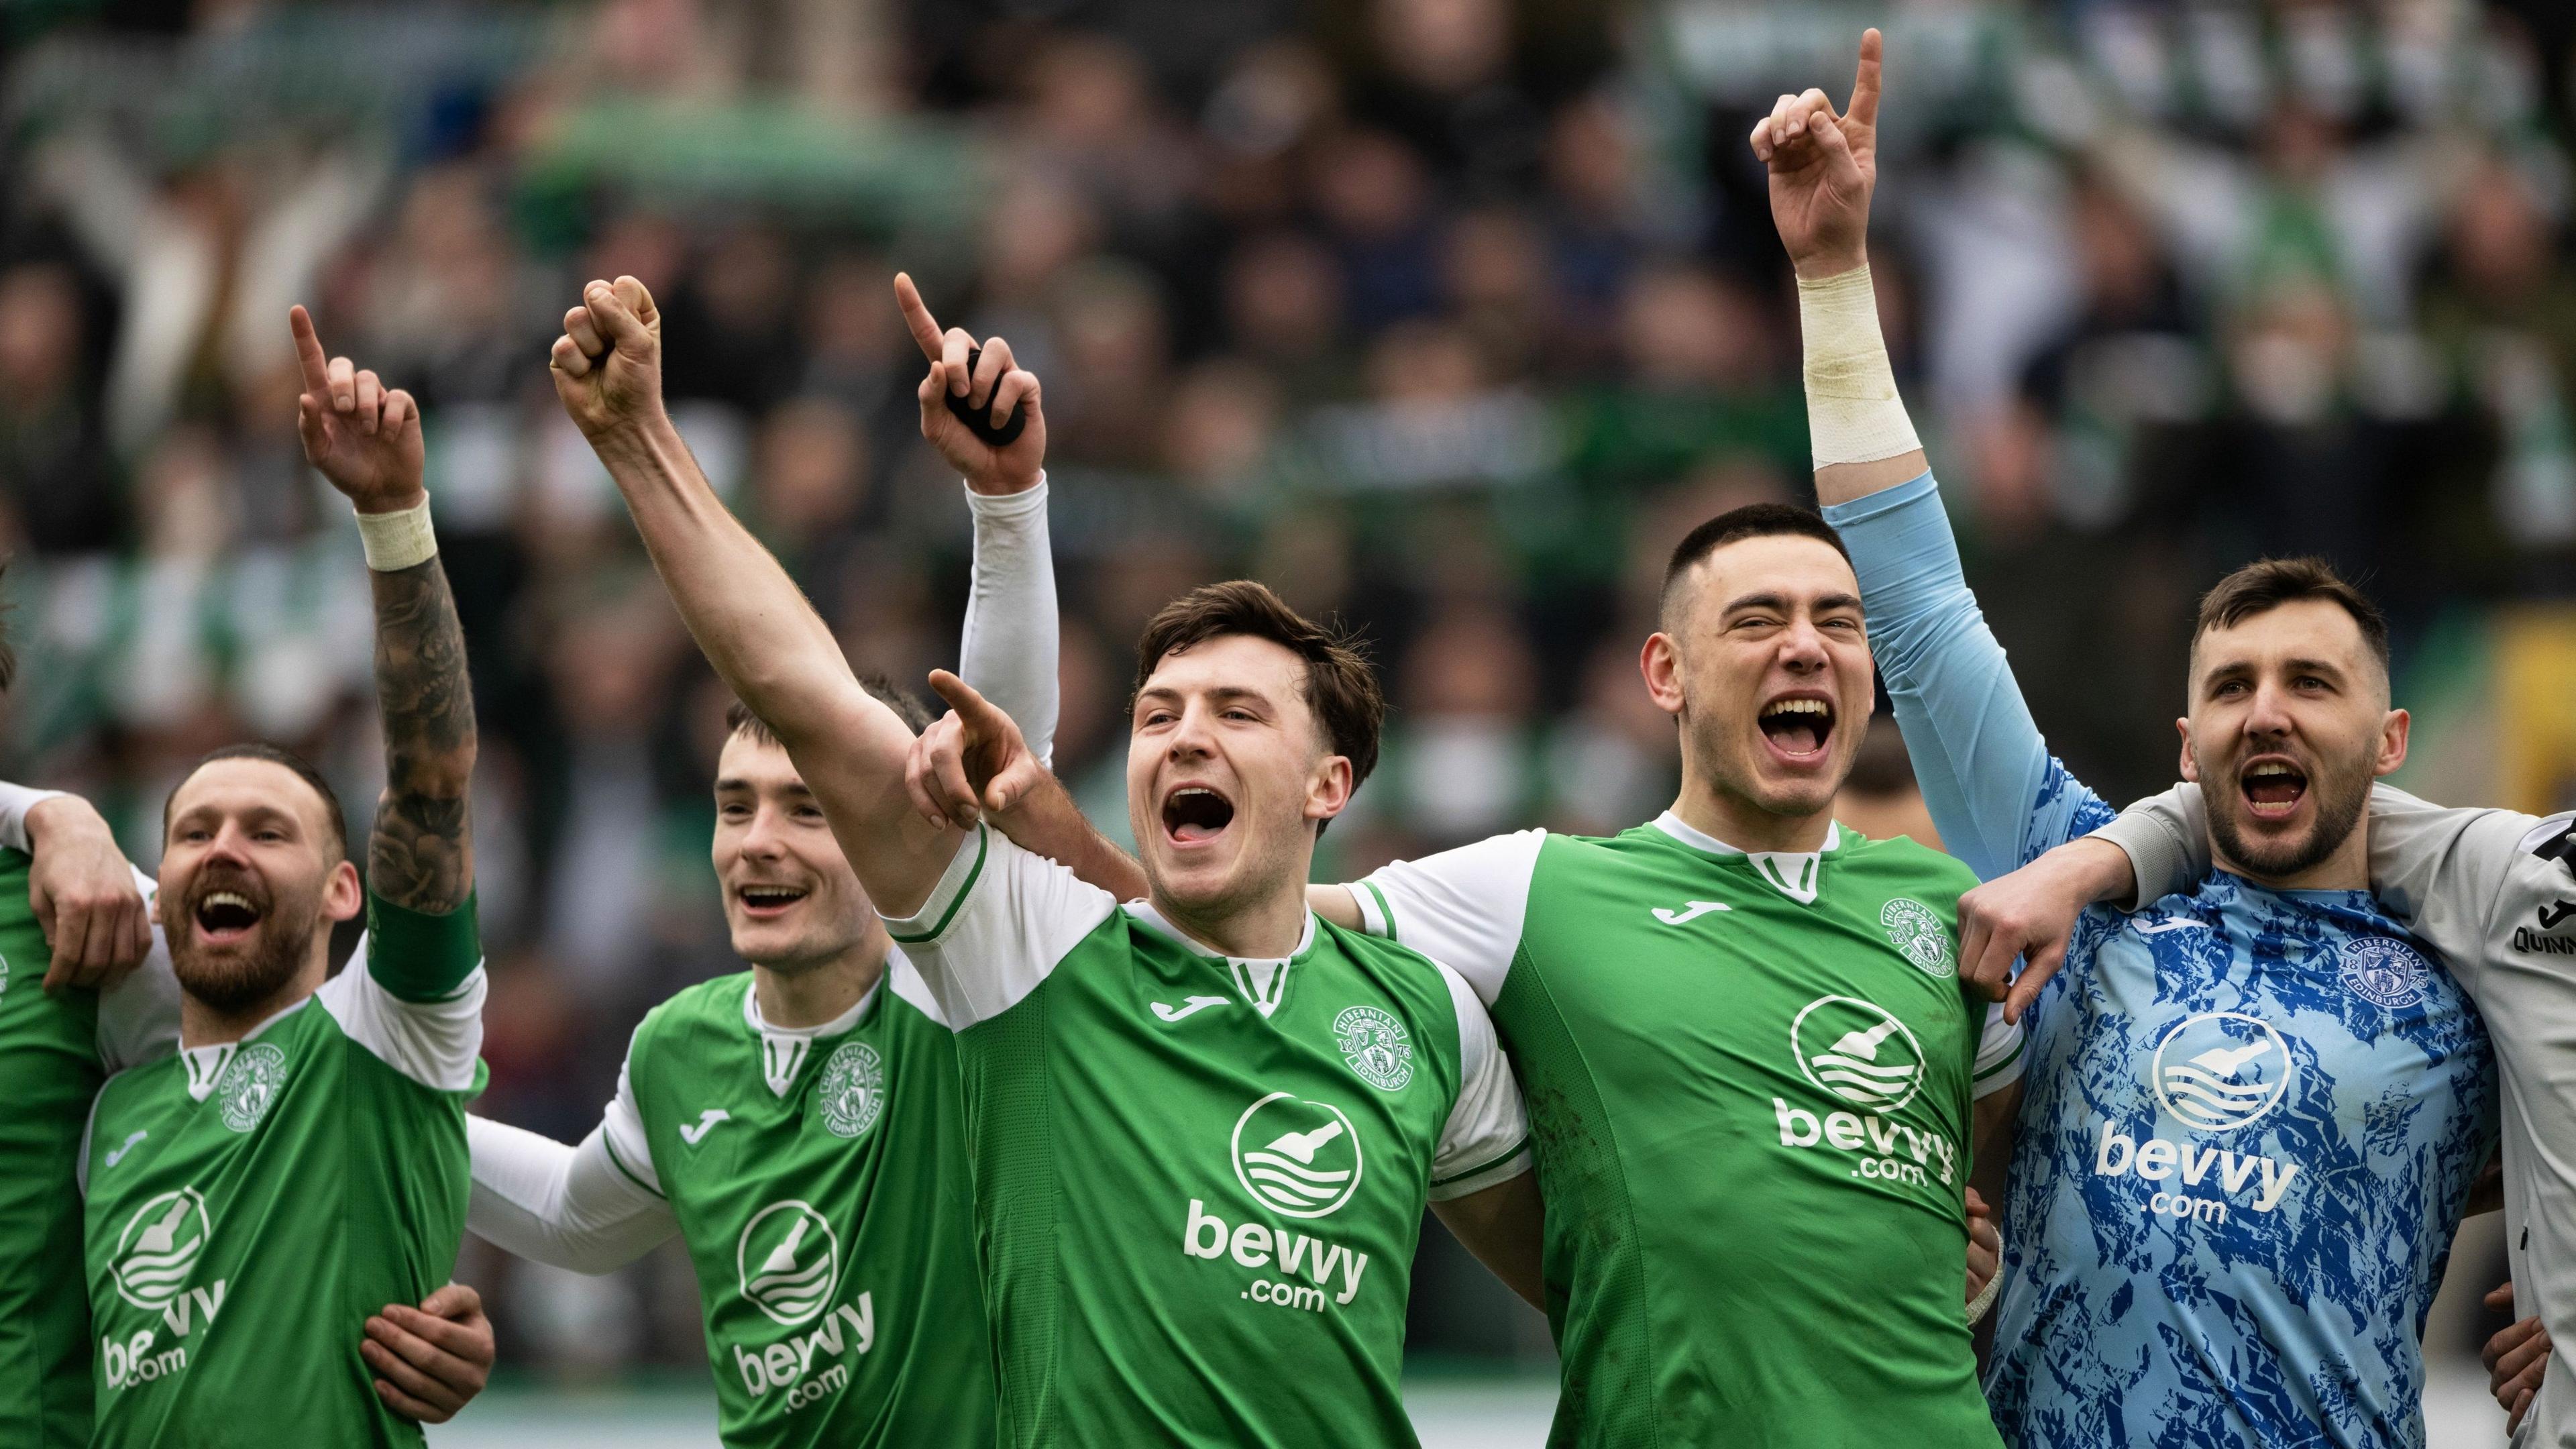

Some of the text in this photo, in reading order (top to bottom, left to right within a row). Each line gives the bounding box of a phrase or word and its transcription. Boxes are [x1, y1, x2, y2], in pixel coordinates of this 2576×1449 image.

[1885, 901, 1937, 924] HIBERNIAN
[1886, 930, 1906, 944] 18
[2349, 939, 2422, 966] HIBERNIAN
[1908, 953, 1953, 974] EDINBURGH
[2339, 956, 2428, 988] 18 75
[2349, 979, 2416, 1006] EDINBURGH
[1338, 1009, 1401, 1033] HIBERNIAN
[1337, 1038, 1411, 1059] 18 75
[1354, 1061, 1409, 1087] EDINBURGH
[830, 1097, 879, 1133] EDINBURGH
[1772, 1097, 1954, 1186] bevvy
[1851, 1157, 1927, 1187] .com
[2095, 1121, 2300, 1213] bevvy
[2141, 1192, 2226, 1224] .com
[1184, 1199, 1368, 1304] bevvy
[1241, 1279, 1325, 1313] .com
[733, 1291, 874, 1397] bevvy
[784, 1364, 848, 1414] .com
